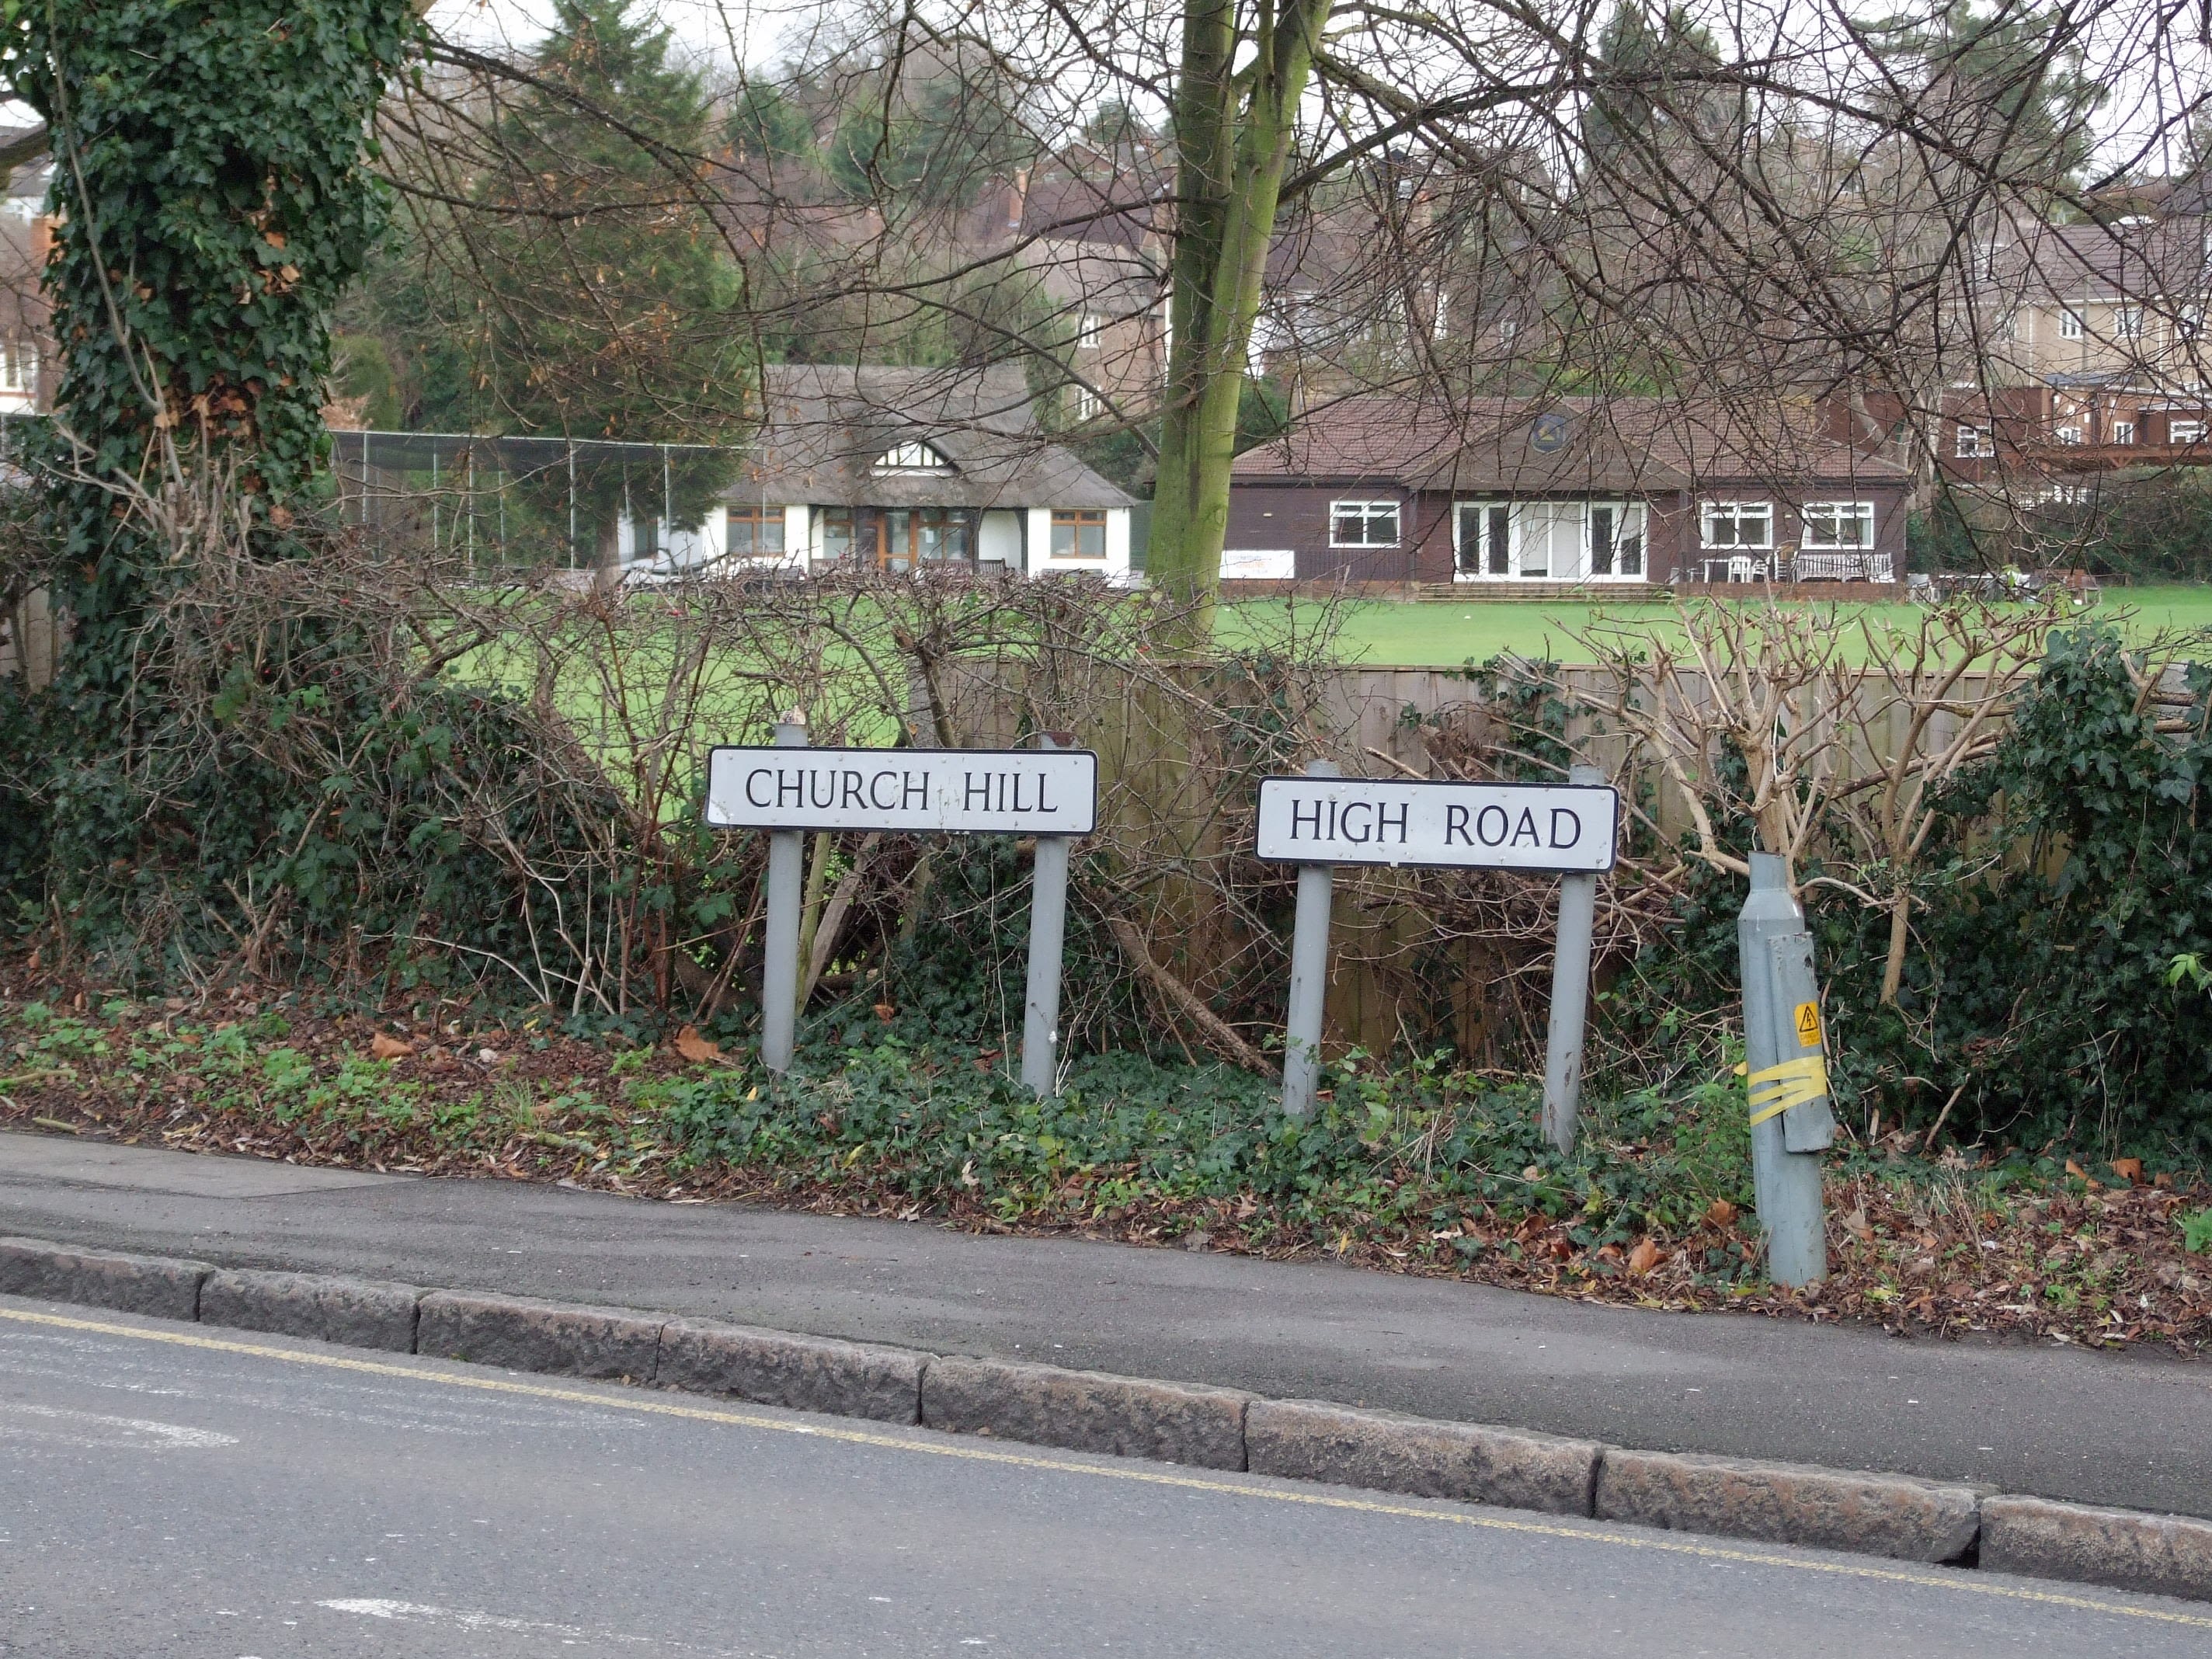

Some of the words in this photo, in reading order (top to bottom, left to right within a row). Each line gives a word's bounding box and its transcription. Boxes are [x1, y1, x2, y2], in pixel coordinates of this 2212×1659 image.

[746, 769, 930, 811] CHURCH
[962, 772, 1058, 813] HILL
[1290, 799, 1409, 843] HIGH
[1445, 805, 1581, 849] ROAD
